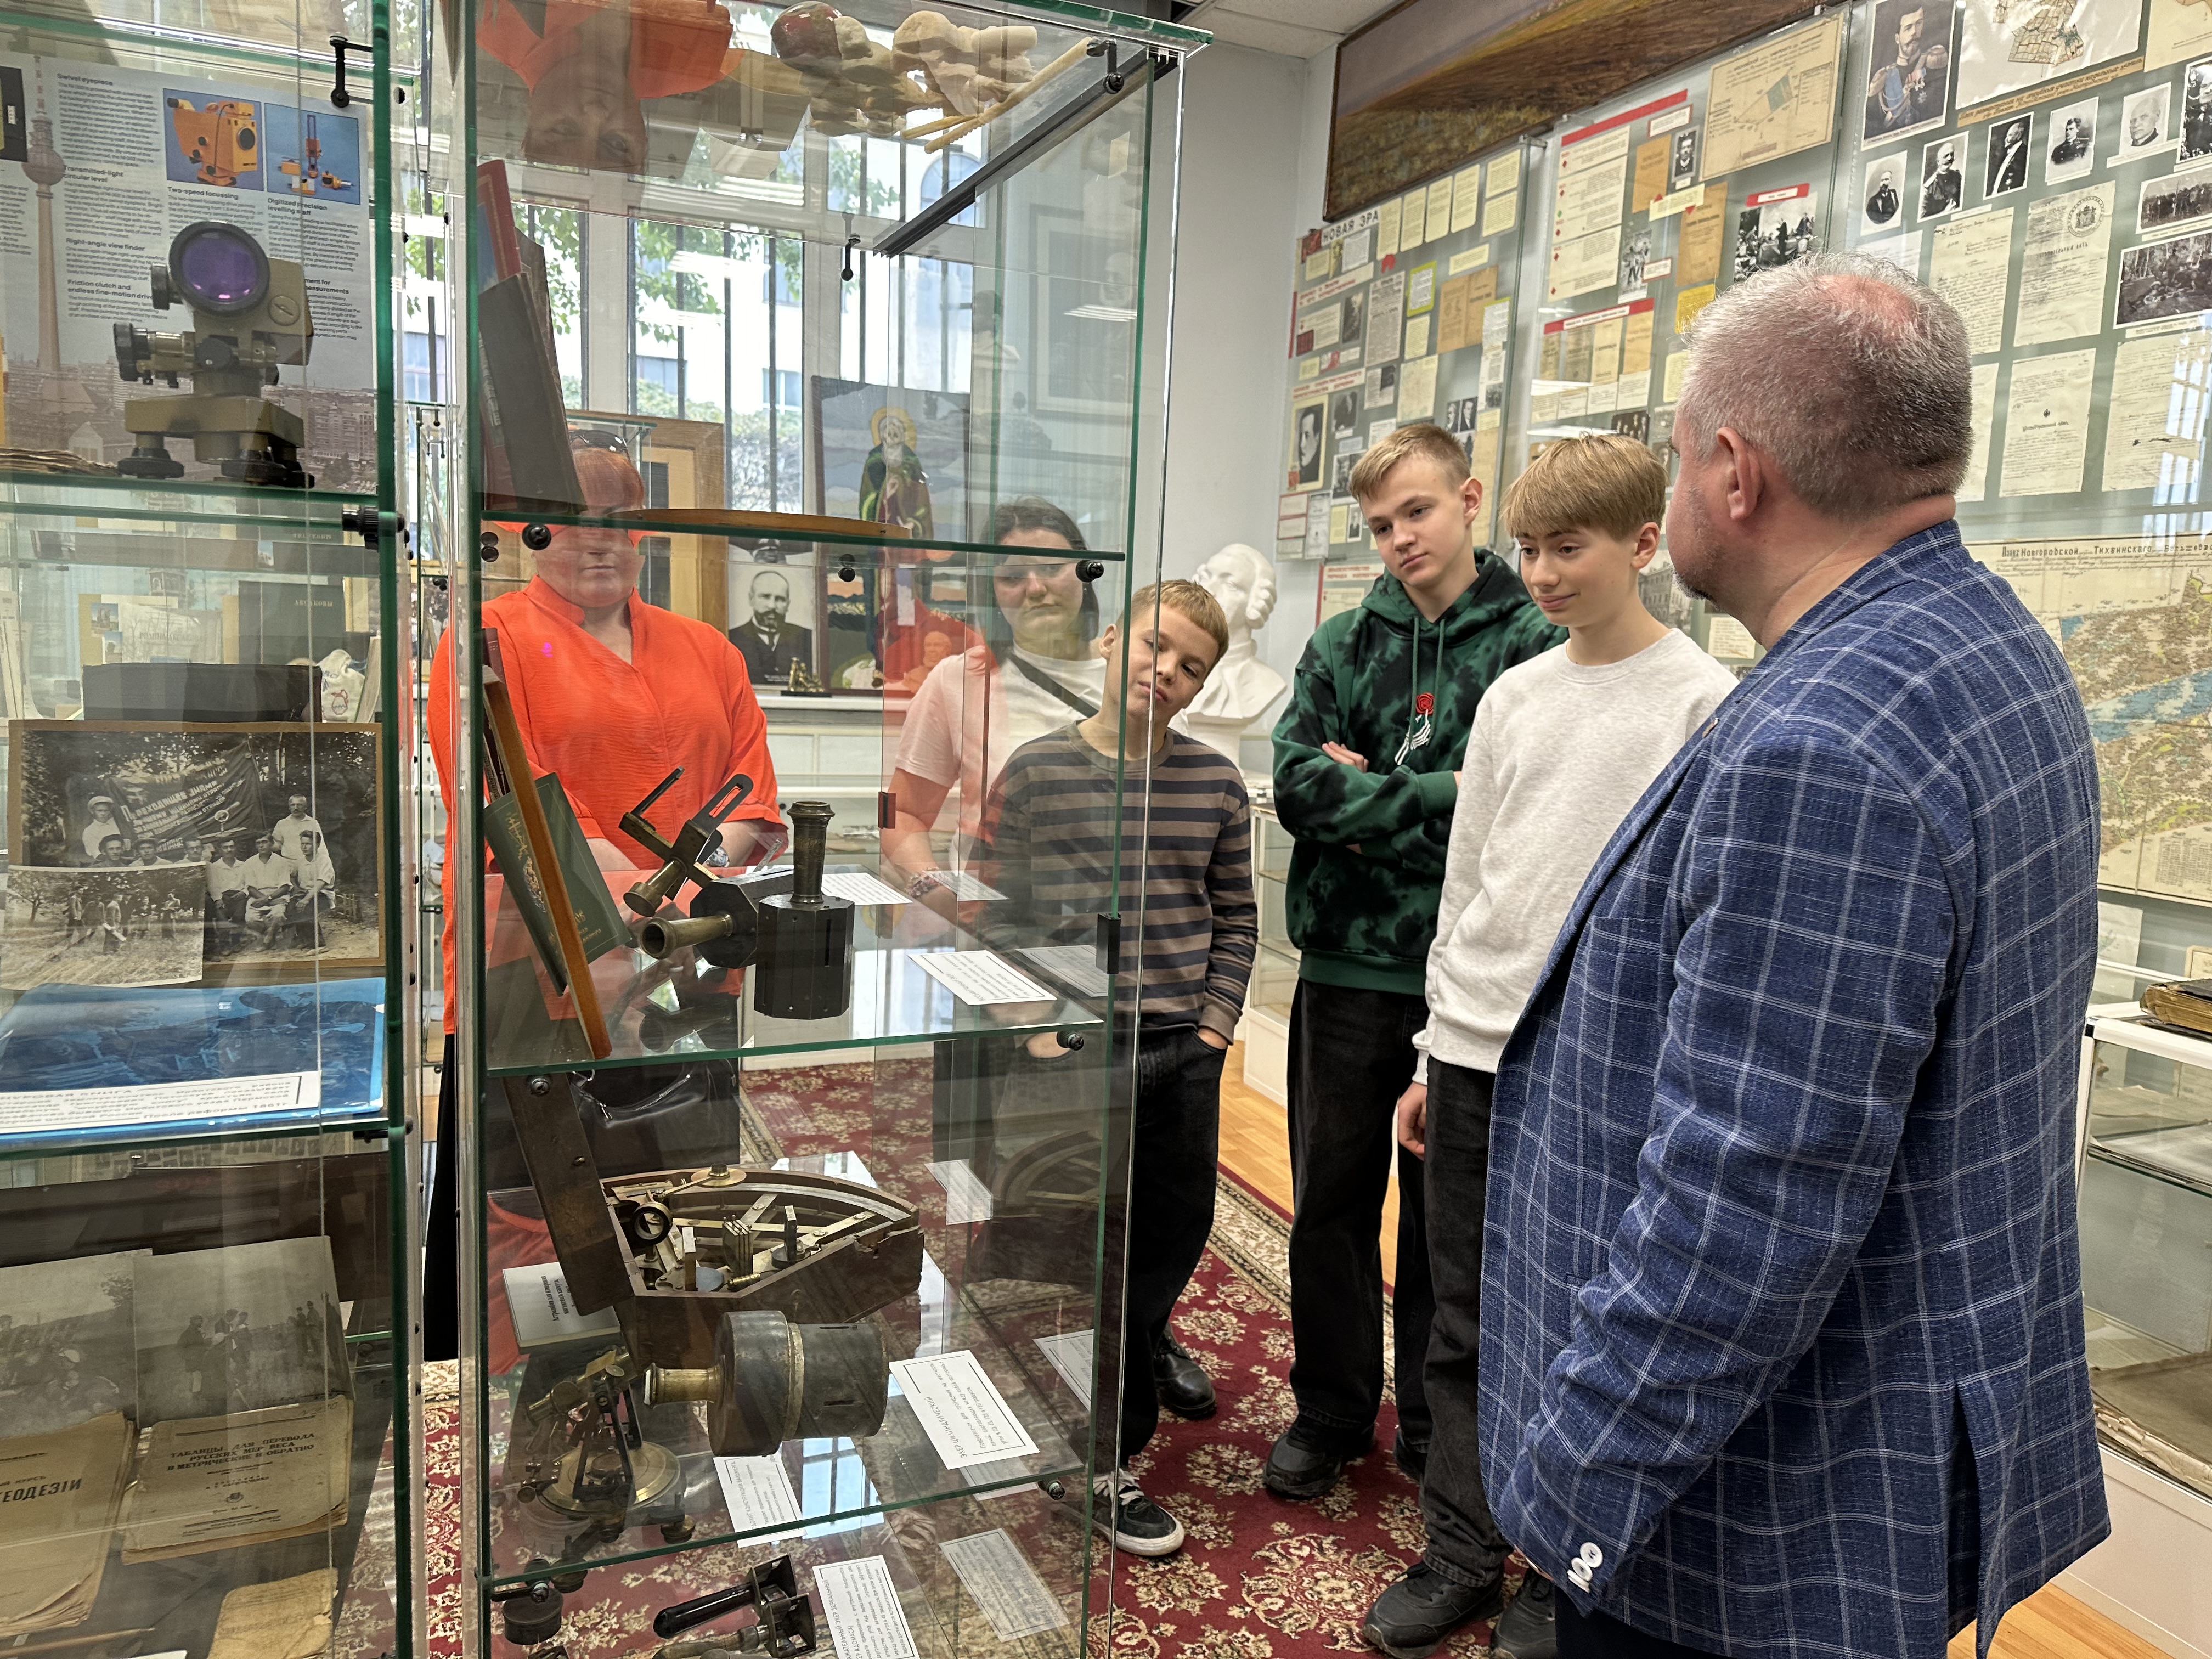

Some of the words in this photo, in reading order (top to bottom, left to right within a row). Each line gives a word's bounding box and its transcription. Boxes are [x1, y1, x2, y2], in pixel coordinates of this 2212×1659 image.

[167, 187, 204, 196] Two-speed
[1323, 219, 1355, 243] НОВАЯ
[1359, 210, 1379, 227] ЭРА
[66, 238, 107, 247] Right-angle
[2021, 548, 2079, 558] Новгородской
[2094, 545, 2152, 555] Тихвинскаго
[923, 1396, 960, 1444] ЦИЛИНДРИЧЕСКИЙ
[262, 1432, 315, 1444] ПЕРЕВОДА
[177, 1453, 251, 1470] МЕТРИЧЕСКИЕ
[266, 1444, 314, 1456] ОБРАТНО
[189, 1449, 238, 1462] РУССКИХ
[243, 1446, 264, 1454] МЕР
[269, 1441, 295, 1449] ВЕСА
[953, 1444, 968, 1458] ЭКЕР
[0, 1478, 82, 1503] ЕОДЕЗІИ
[821, 1579, 837, 1611] ЗЕРКАЛЬНЫЙ
[832, 1611, 841, 1624] ЭКЕР
[847, 1624, 861, 1651] АДОМАСА)
